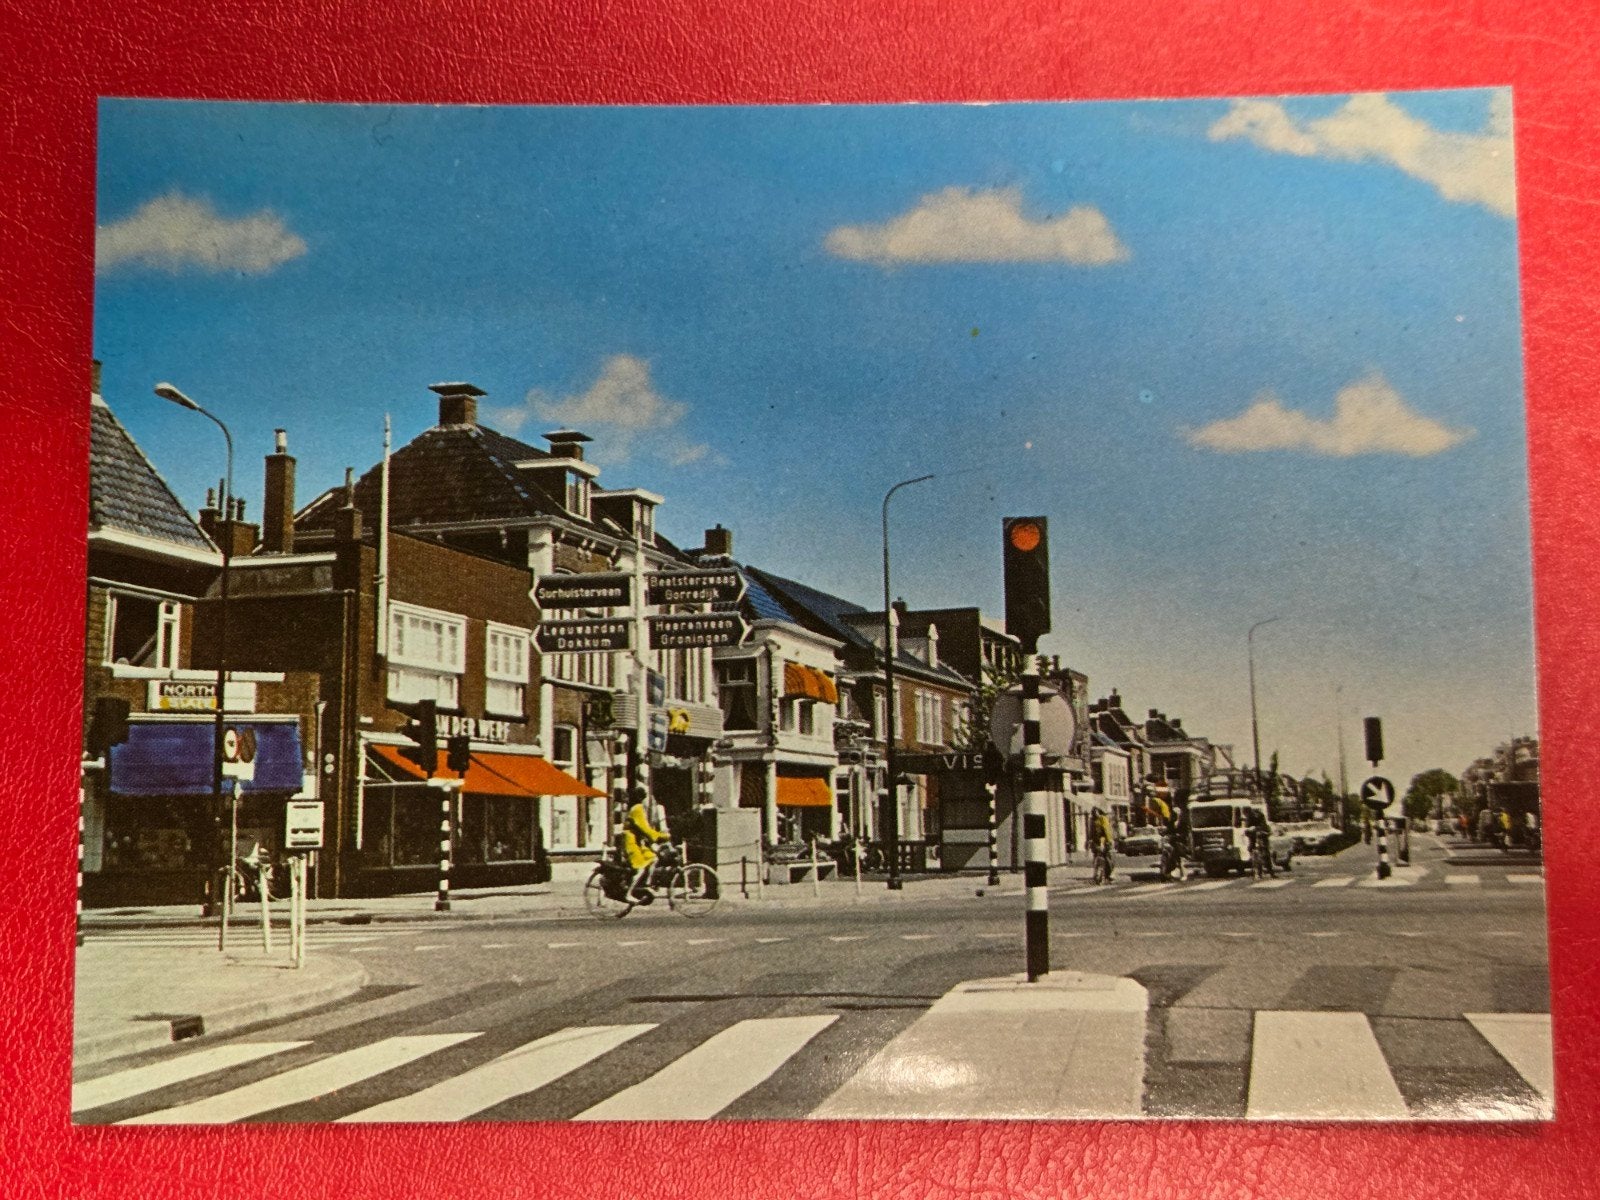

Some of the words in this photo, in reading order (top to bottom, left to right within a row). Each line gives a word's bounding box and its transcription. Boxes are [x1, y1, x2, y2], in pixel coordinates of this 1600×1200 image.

[542, 624, 625, 636] Leeuwarden
[655, 620, 734, 632] Heerenveen
[557, 637, 612, 649] Dokkum
[660, 633, 729, 646] Groningen
[163, 684, 216, 697] NORTH
[942, 754, 984, 770] VIS
